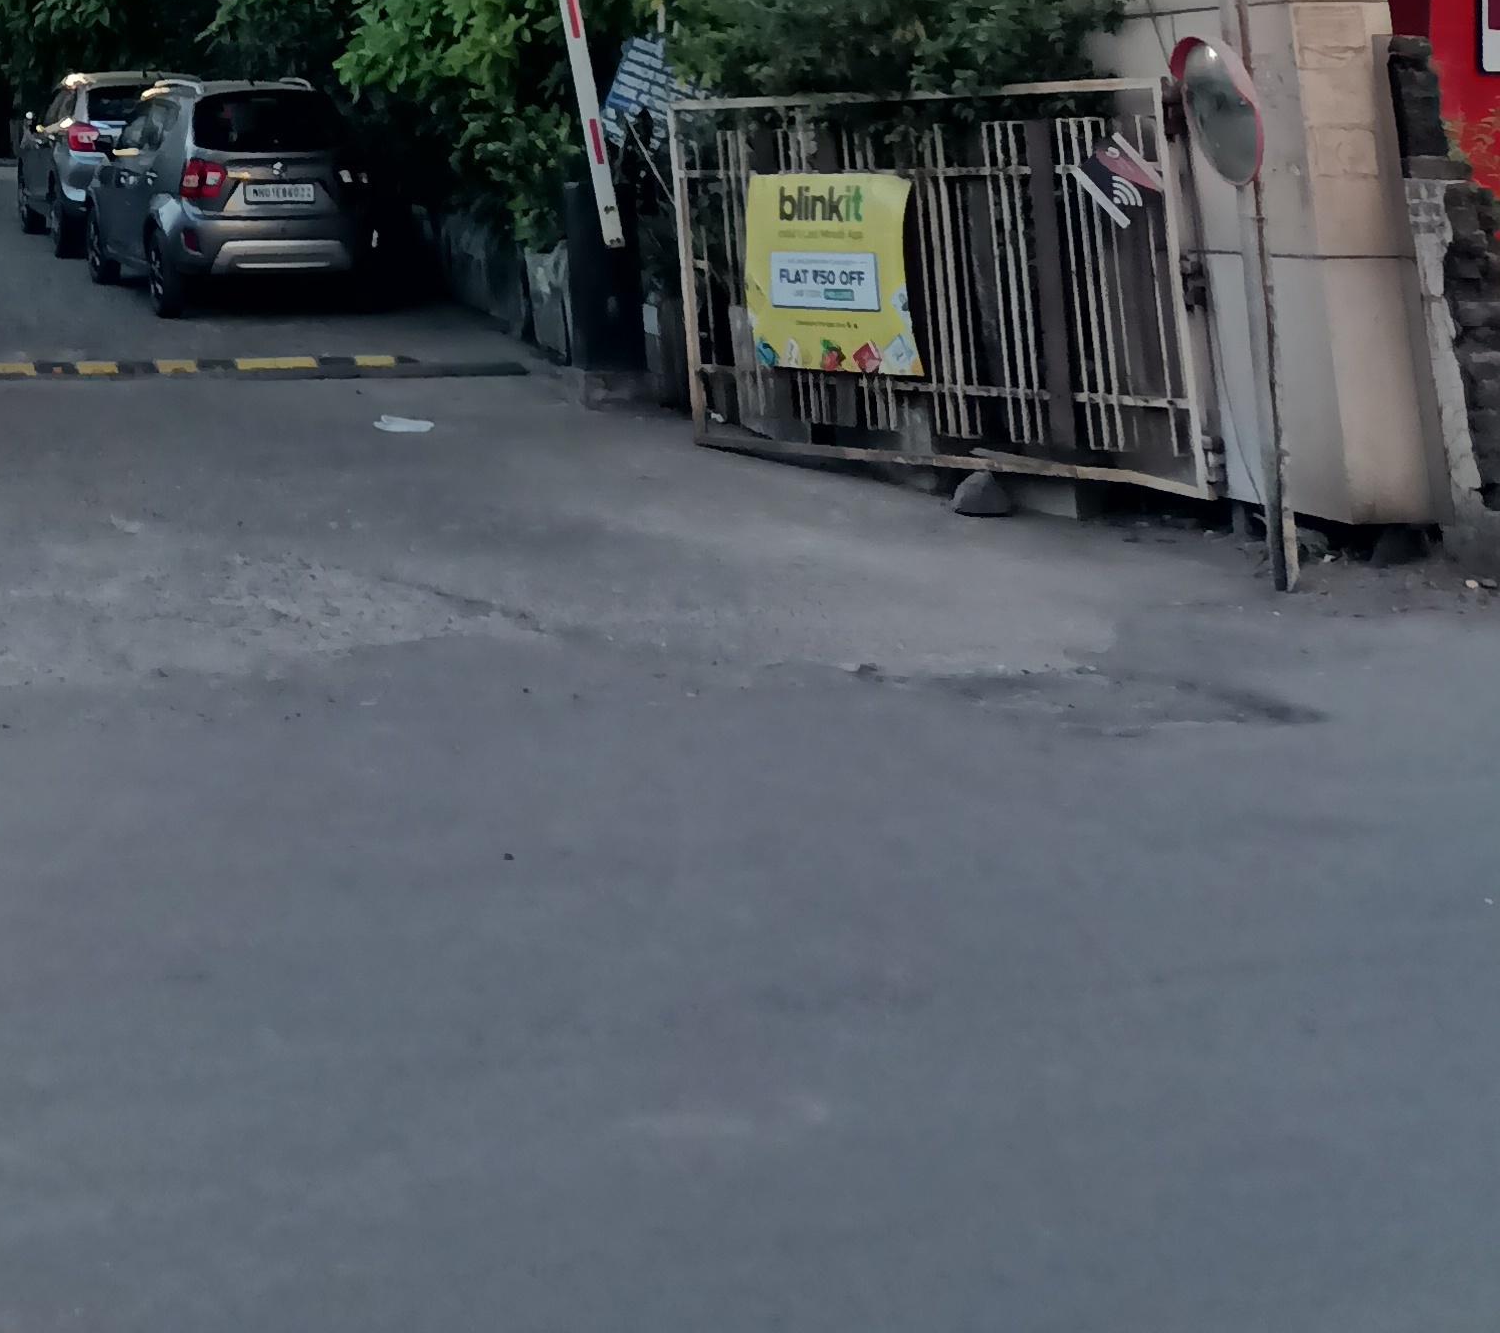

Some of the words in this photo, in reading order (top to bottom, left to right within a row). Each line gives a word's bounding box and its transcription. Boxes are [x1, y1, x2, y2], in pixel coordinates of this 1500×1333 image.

[778, 184, 863, 222] blinkit
[779, 268, 809, 285] FLAT
[839, 269, 865, 286] OFF
